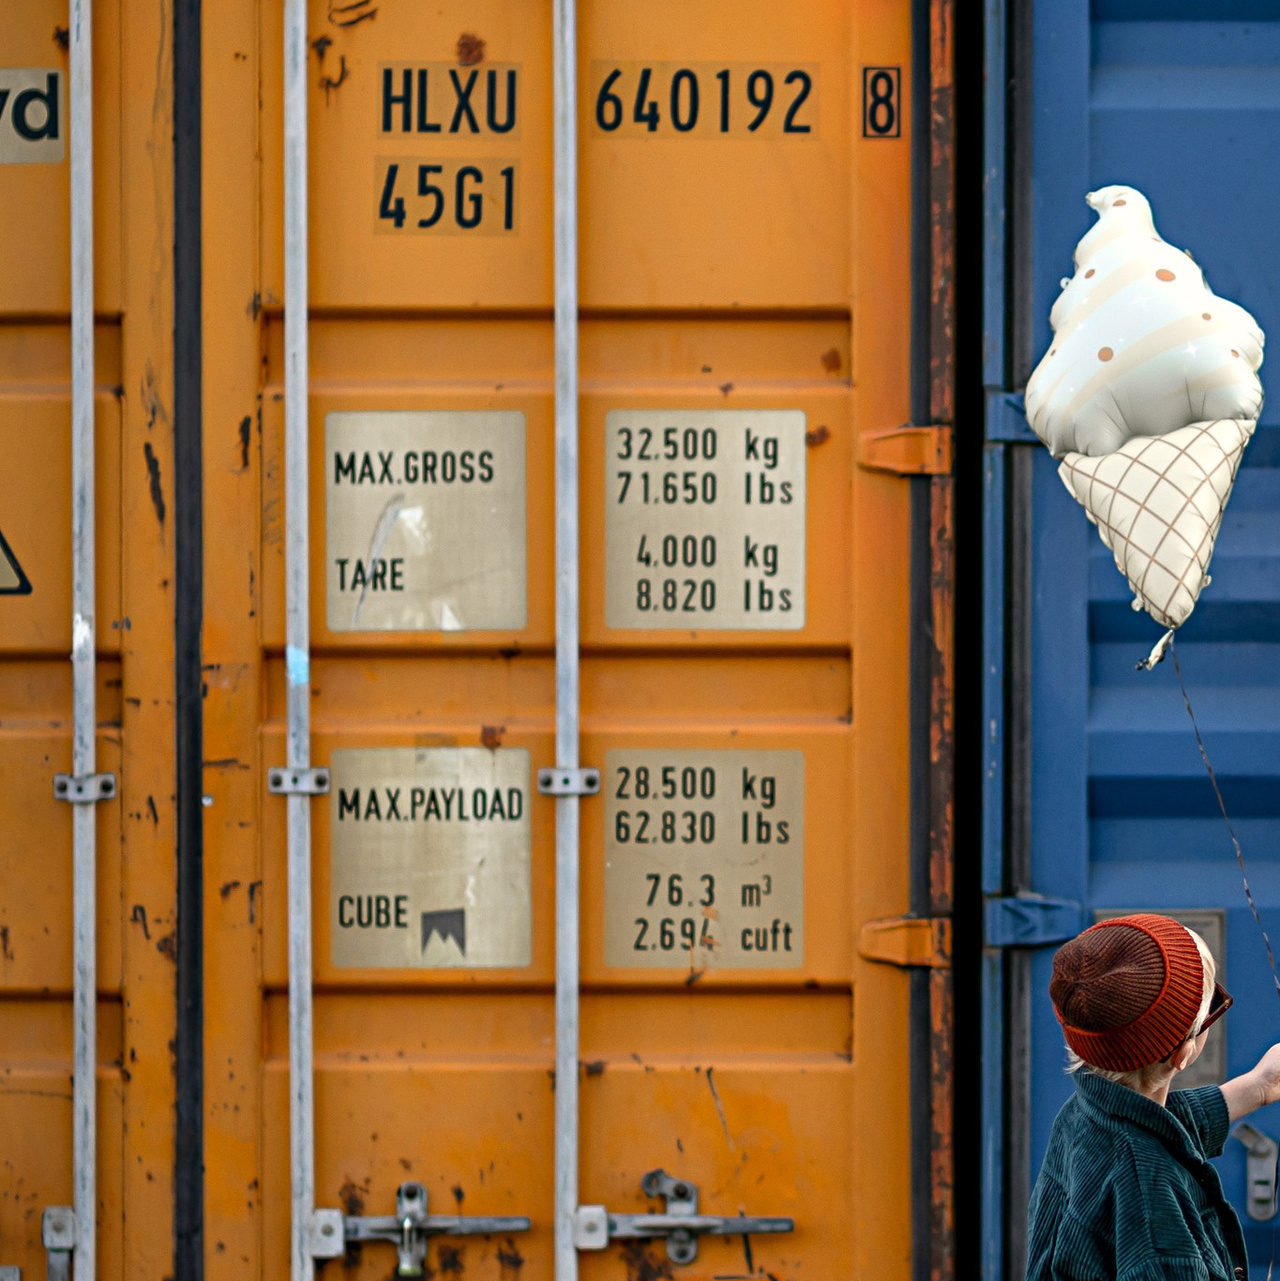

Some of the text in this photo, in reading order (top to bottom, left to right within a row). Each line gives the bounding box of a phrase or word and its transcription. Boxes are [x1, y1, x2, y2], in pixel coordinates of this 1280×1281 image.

[382, 68, 895, 134] HLXU 640192 8
[378, 164, 515, 229] 45G1
[617, 428, 779, 469] 32.500 kg
[617, 471, 793, 505] 71.650 lbs
[637, 535, 779, 577] 4.000 kg
[336, 558, 405, 592] TARE
[637, 579, 792, 612] 8.820 lbs
[615, 766, 776, 809] 28.500 kg
[615, 811, 790, 844] 62.830 lbs
[646, 874, 716, 907] 76.3
[338, 895, 409, 929] CUBE
[633, 918, 793, 952] 2.694 cuft
